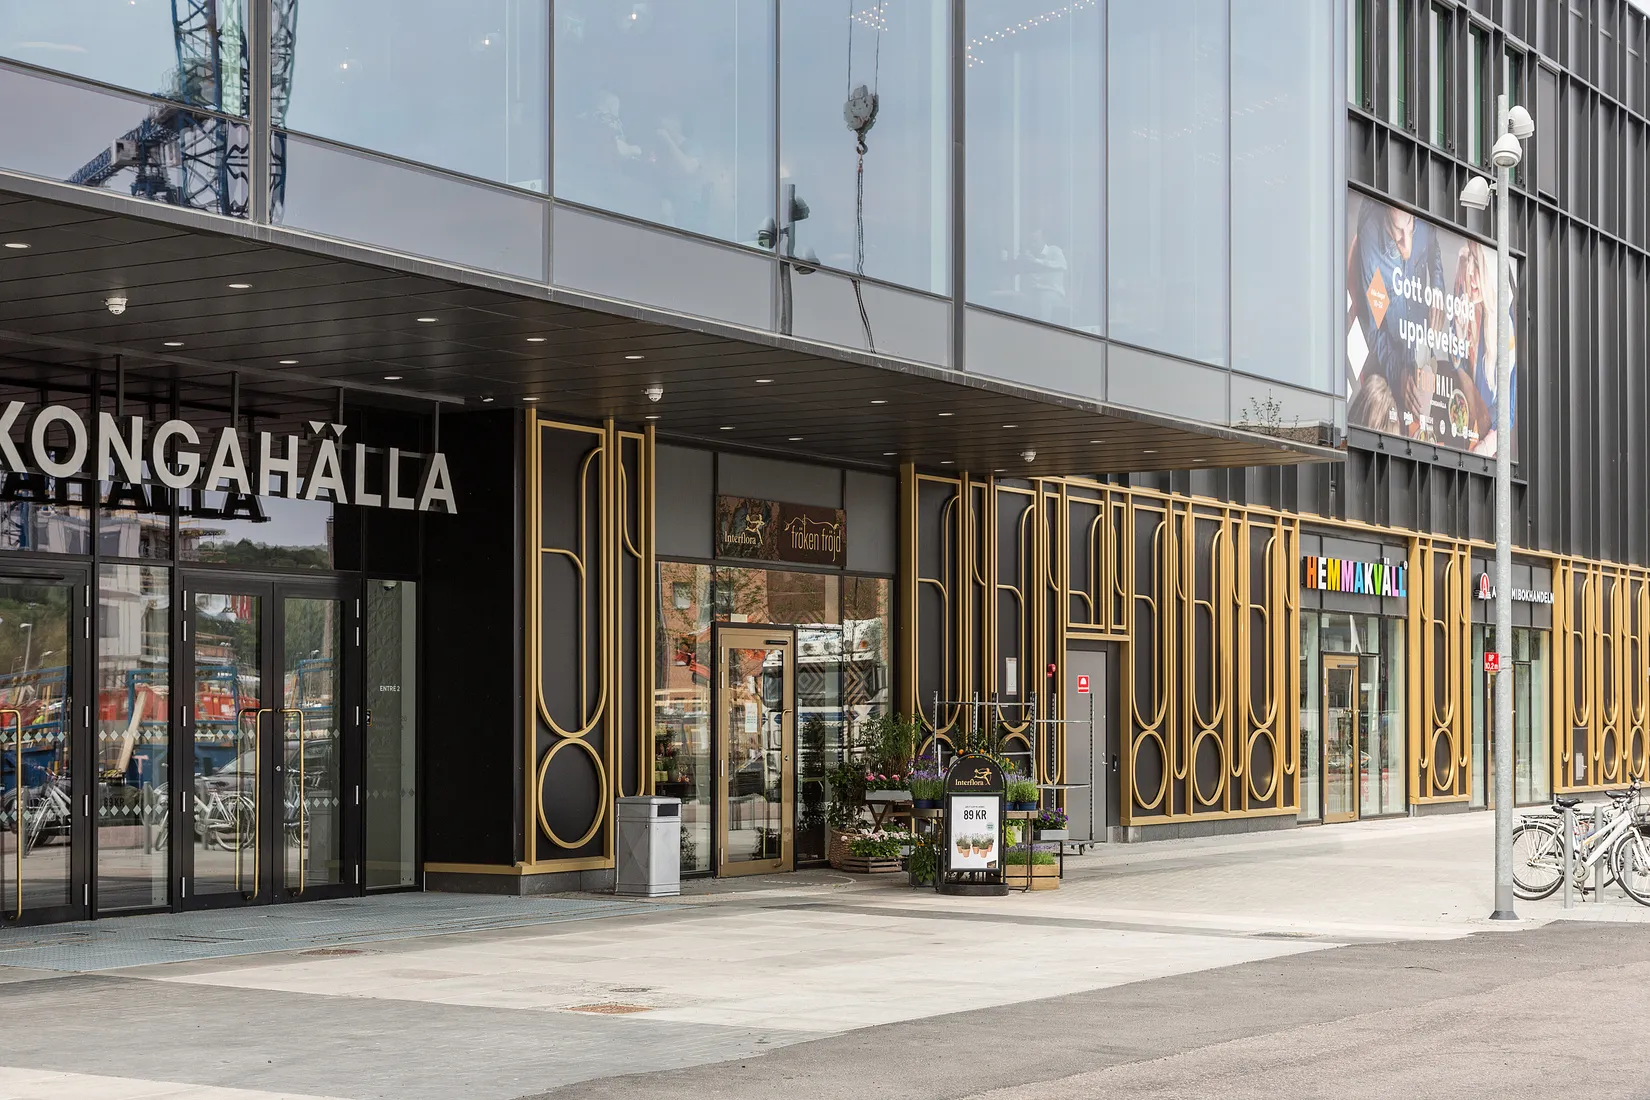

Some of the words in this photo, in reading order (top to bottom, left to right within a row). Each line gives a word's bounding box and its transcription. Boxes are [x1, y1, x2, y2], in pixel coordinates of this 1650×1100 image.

[1393, 267, 1422, 303] Gott
[1425, 286, 1444, 311] om
[1446, 293, 1475, 322] goda
[1400, 318, 1471, 360] upplevelser
[0, 401, 458, 515] KONGAHÄLLA
[724, 531, 757, 545] Interflora
[791, 517, 820, 551] fröken
[821, 528, 842, 561] fröjd
[1307, 555, 1407, 597] HEMMAKVÄLL
[1492, 586, 1554, 604] AMIBOKHANDELN
[1488, 654, 1495, 662] BP
[963, 809, 974, 820] 89
[975, 809, 987, 820] KR
